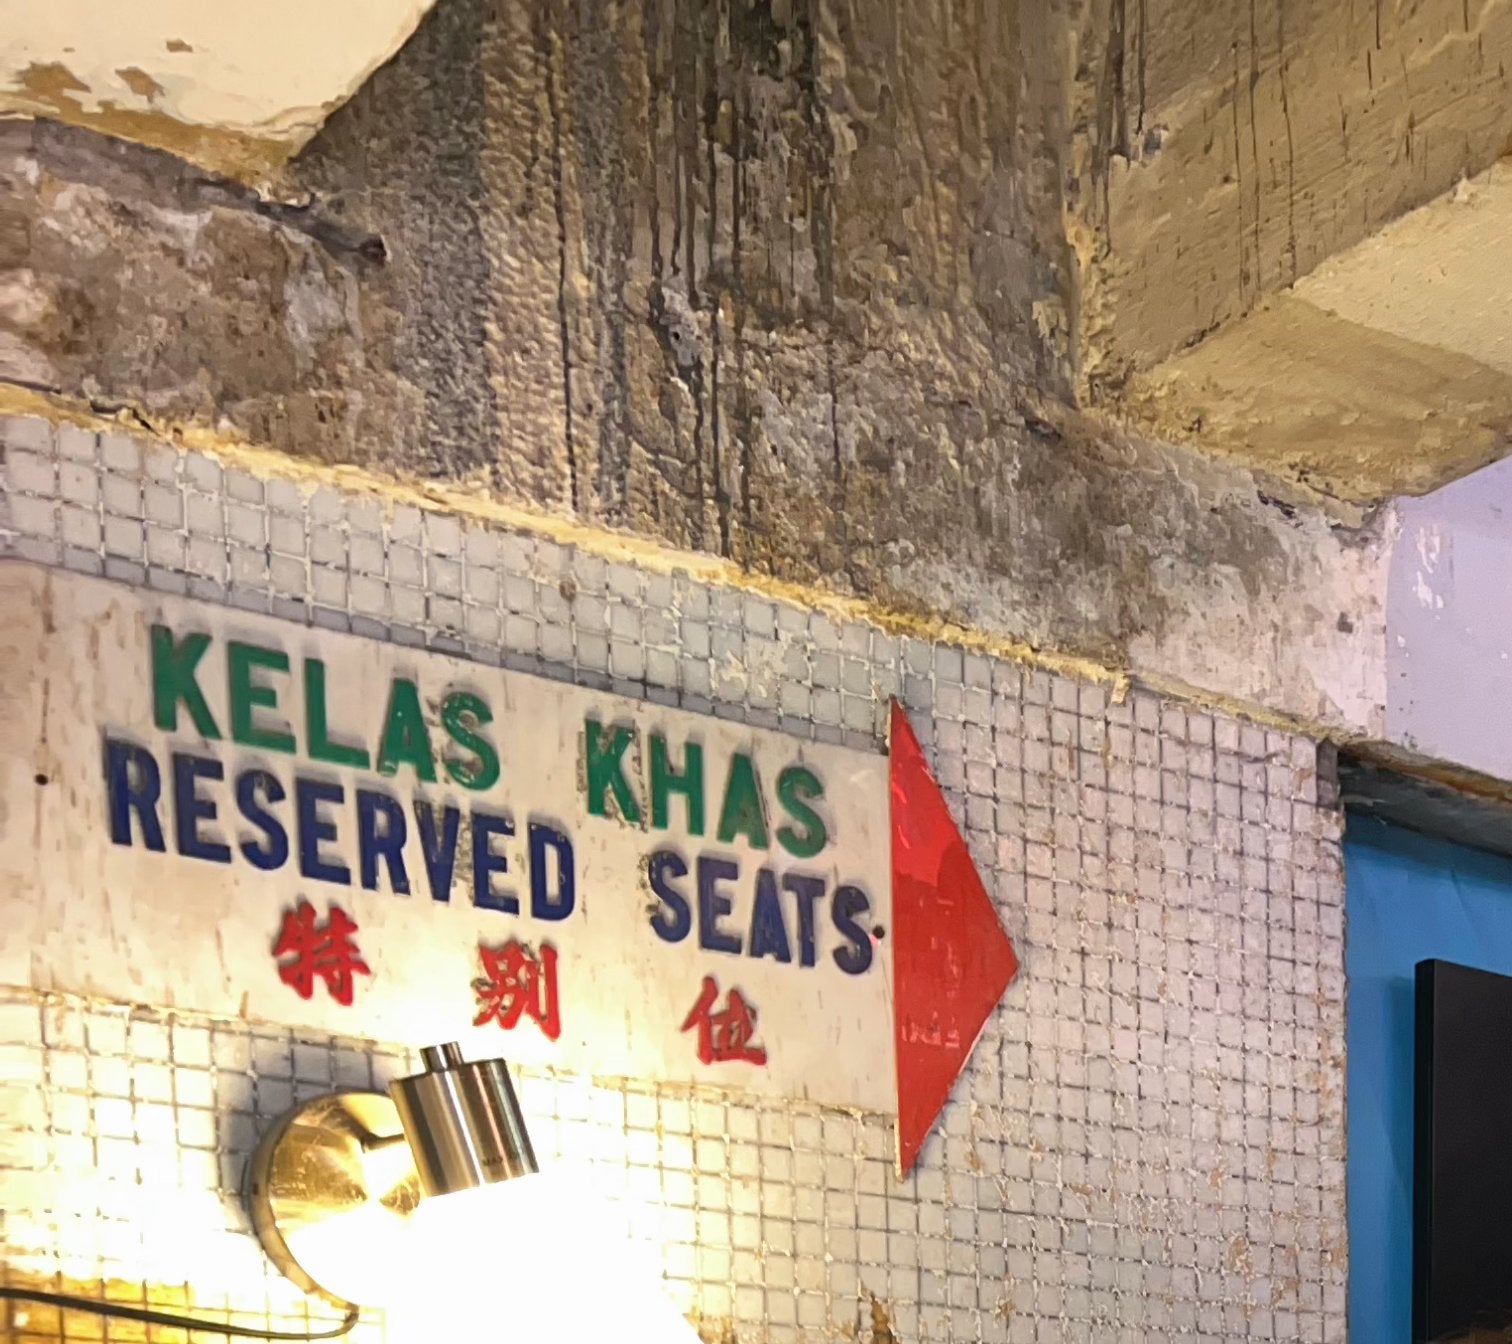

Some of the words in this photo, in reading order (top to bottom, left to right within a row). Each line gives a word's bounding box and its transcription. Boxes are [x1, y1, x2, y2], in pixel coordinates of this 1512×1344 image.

[103, 736, 574, 922] RESERVED
[649, 853, 873, 976] SEATS
[150, 624, 500, 791] KELAS
[585, 713, 830, 858] KHAS
